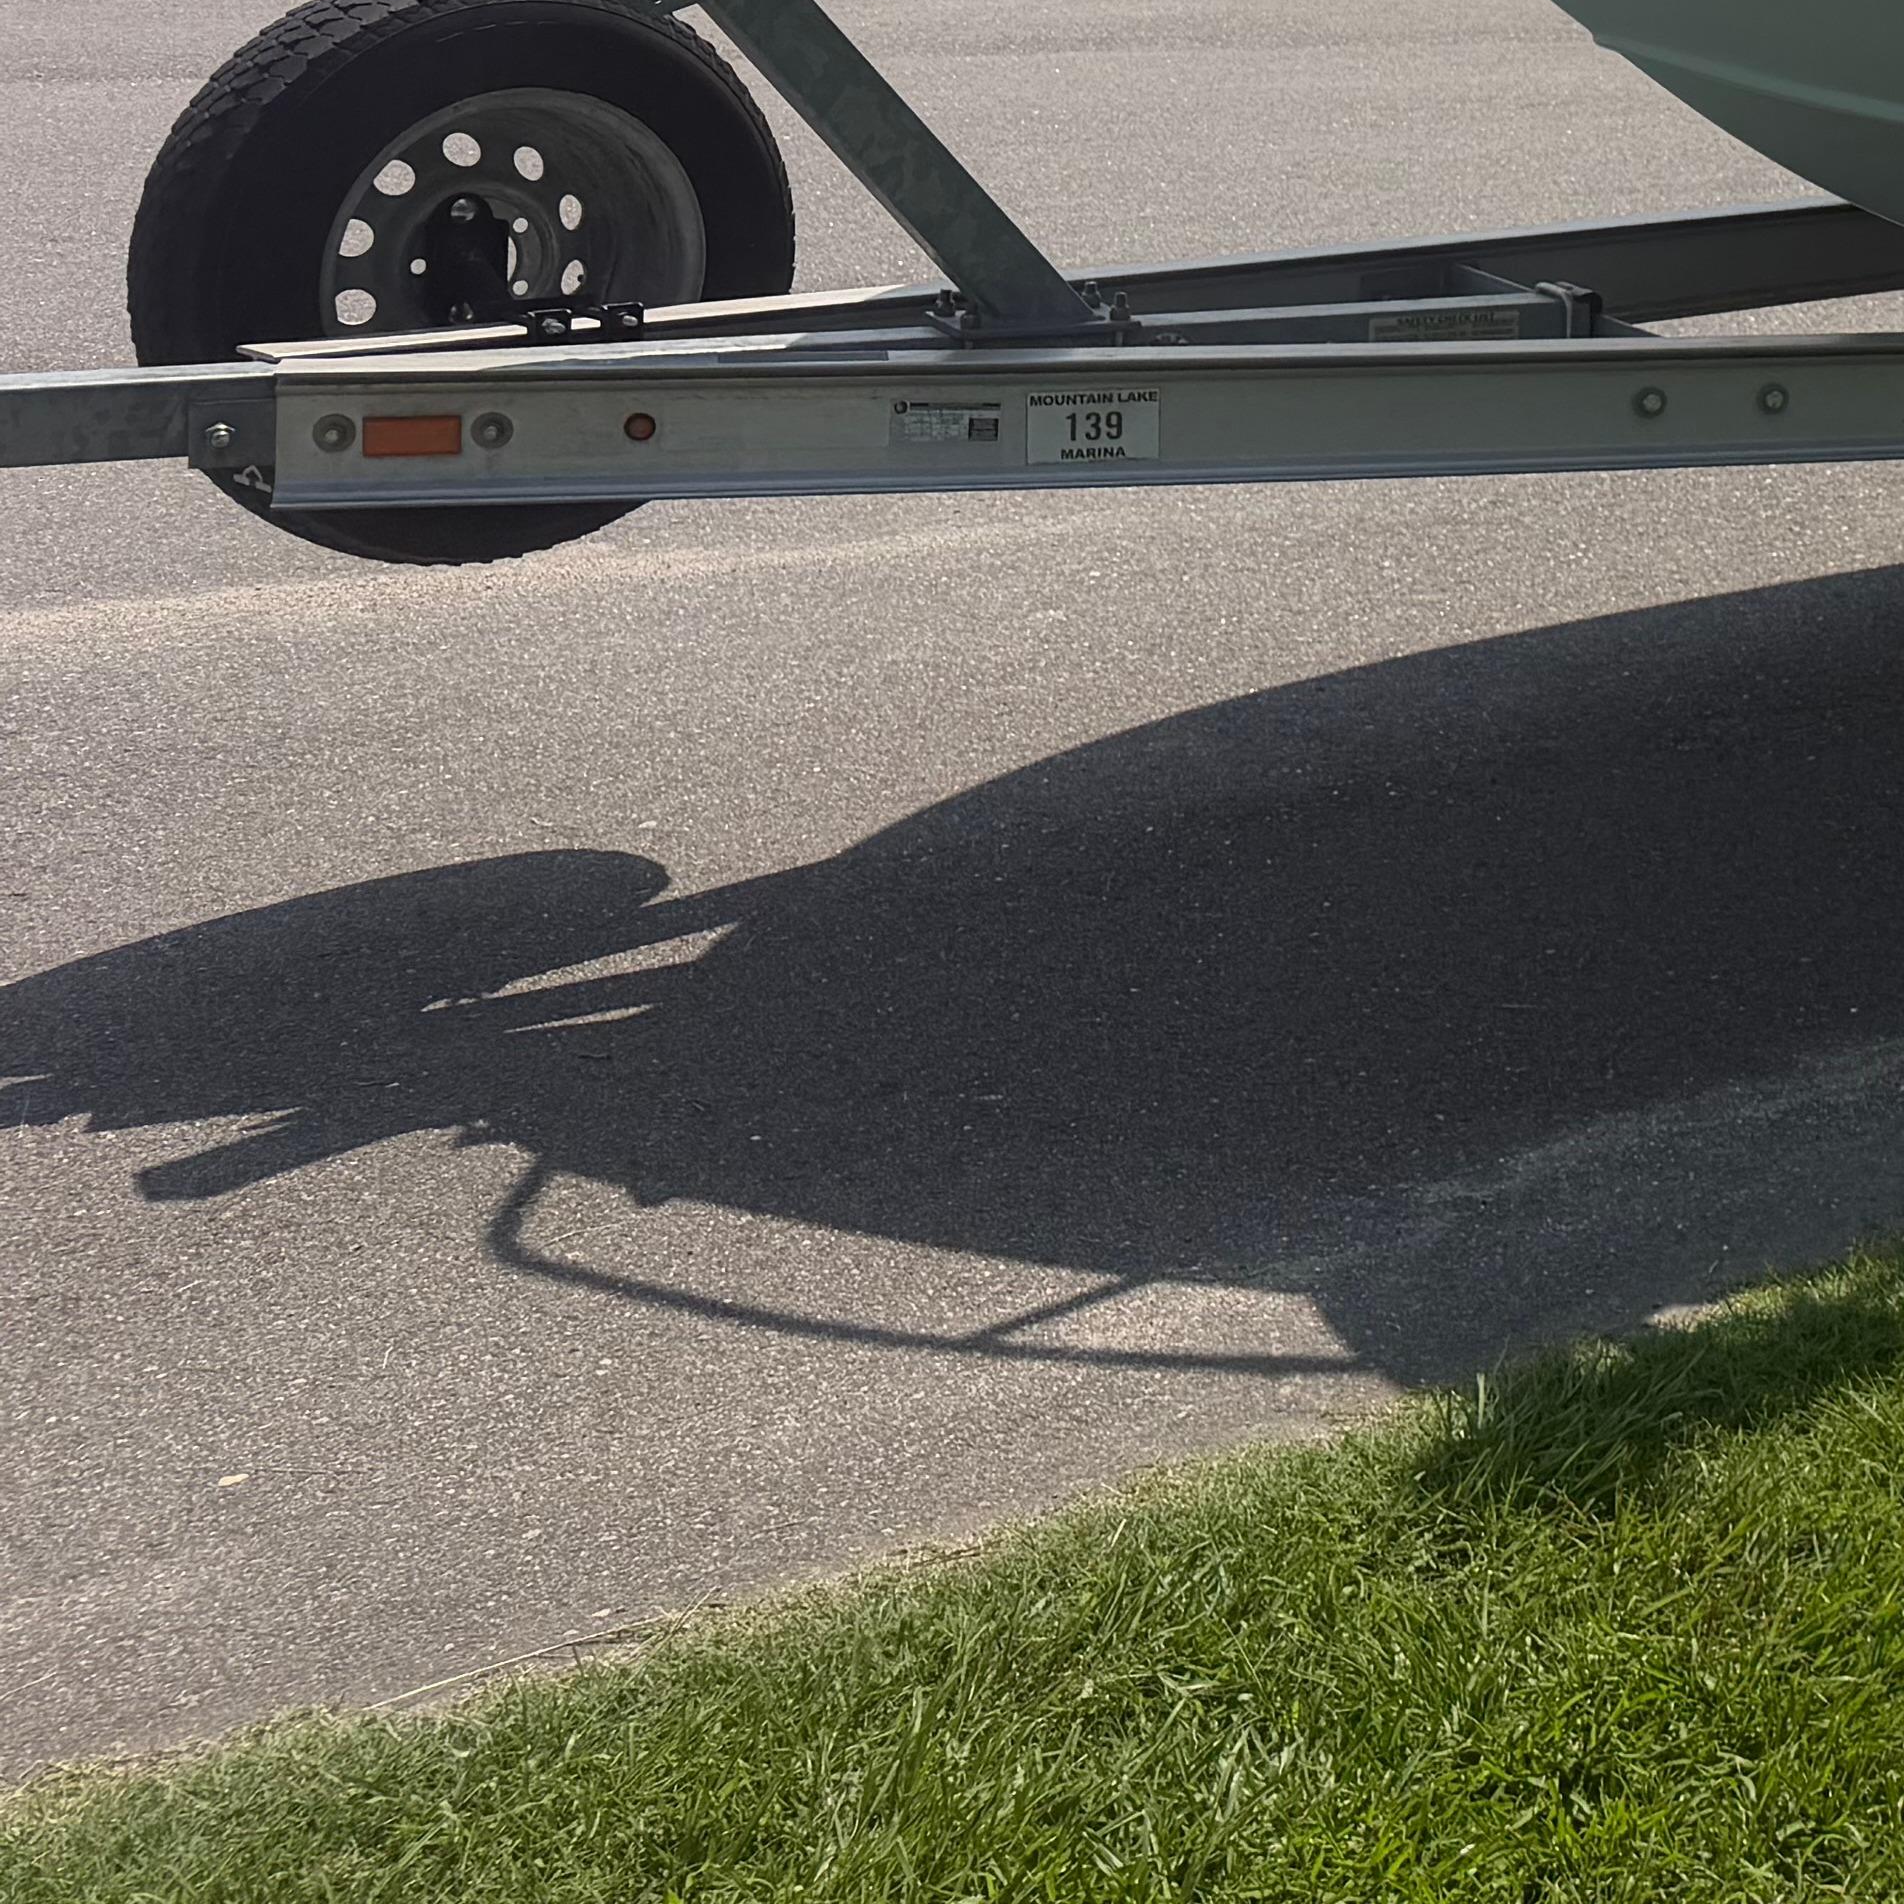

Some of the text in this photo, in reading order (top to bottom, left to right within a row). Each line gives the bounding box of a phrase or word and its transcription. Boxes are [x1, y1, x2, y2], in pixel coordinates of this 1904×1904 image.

[1029, 390, 1159, 407] MOUNTAIN LAKE
[1065, 411, 1123, 442] 139
[1060, 446, 1126, 461] MARINA
